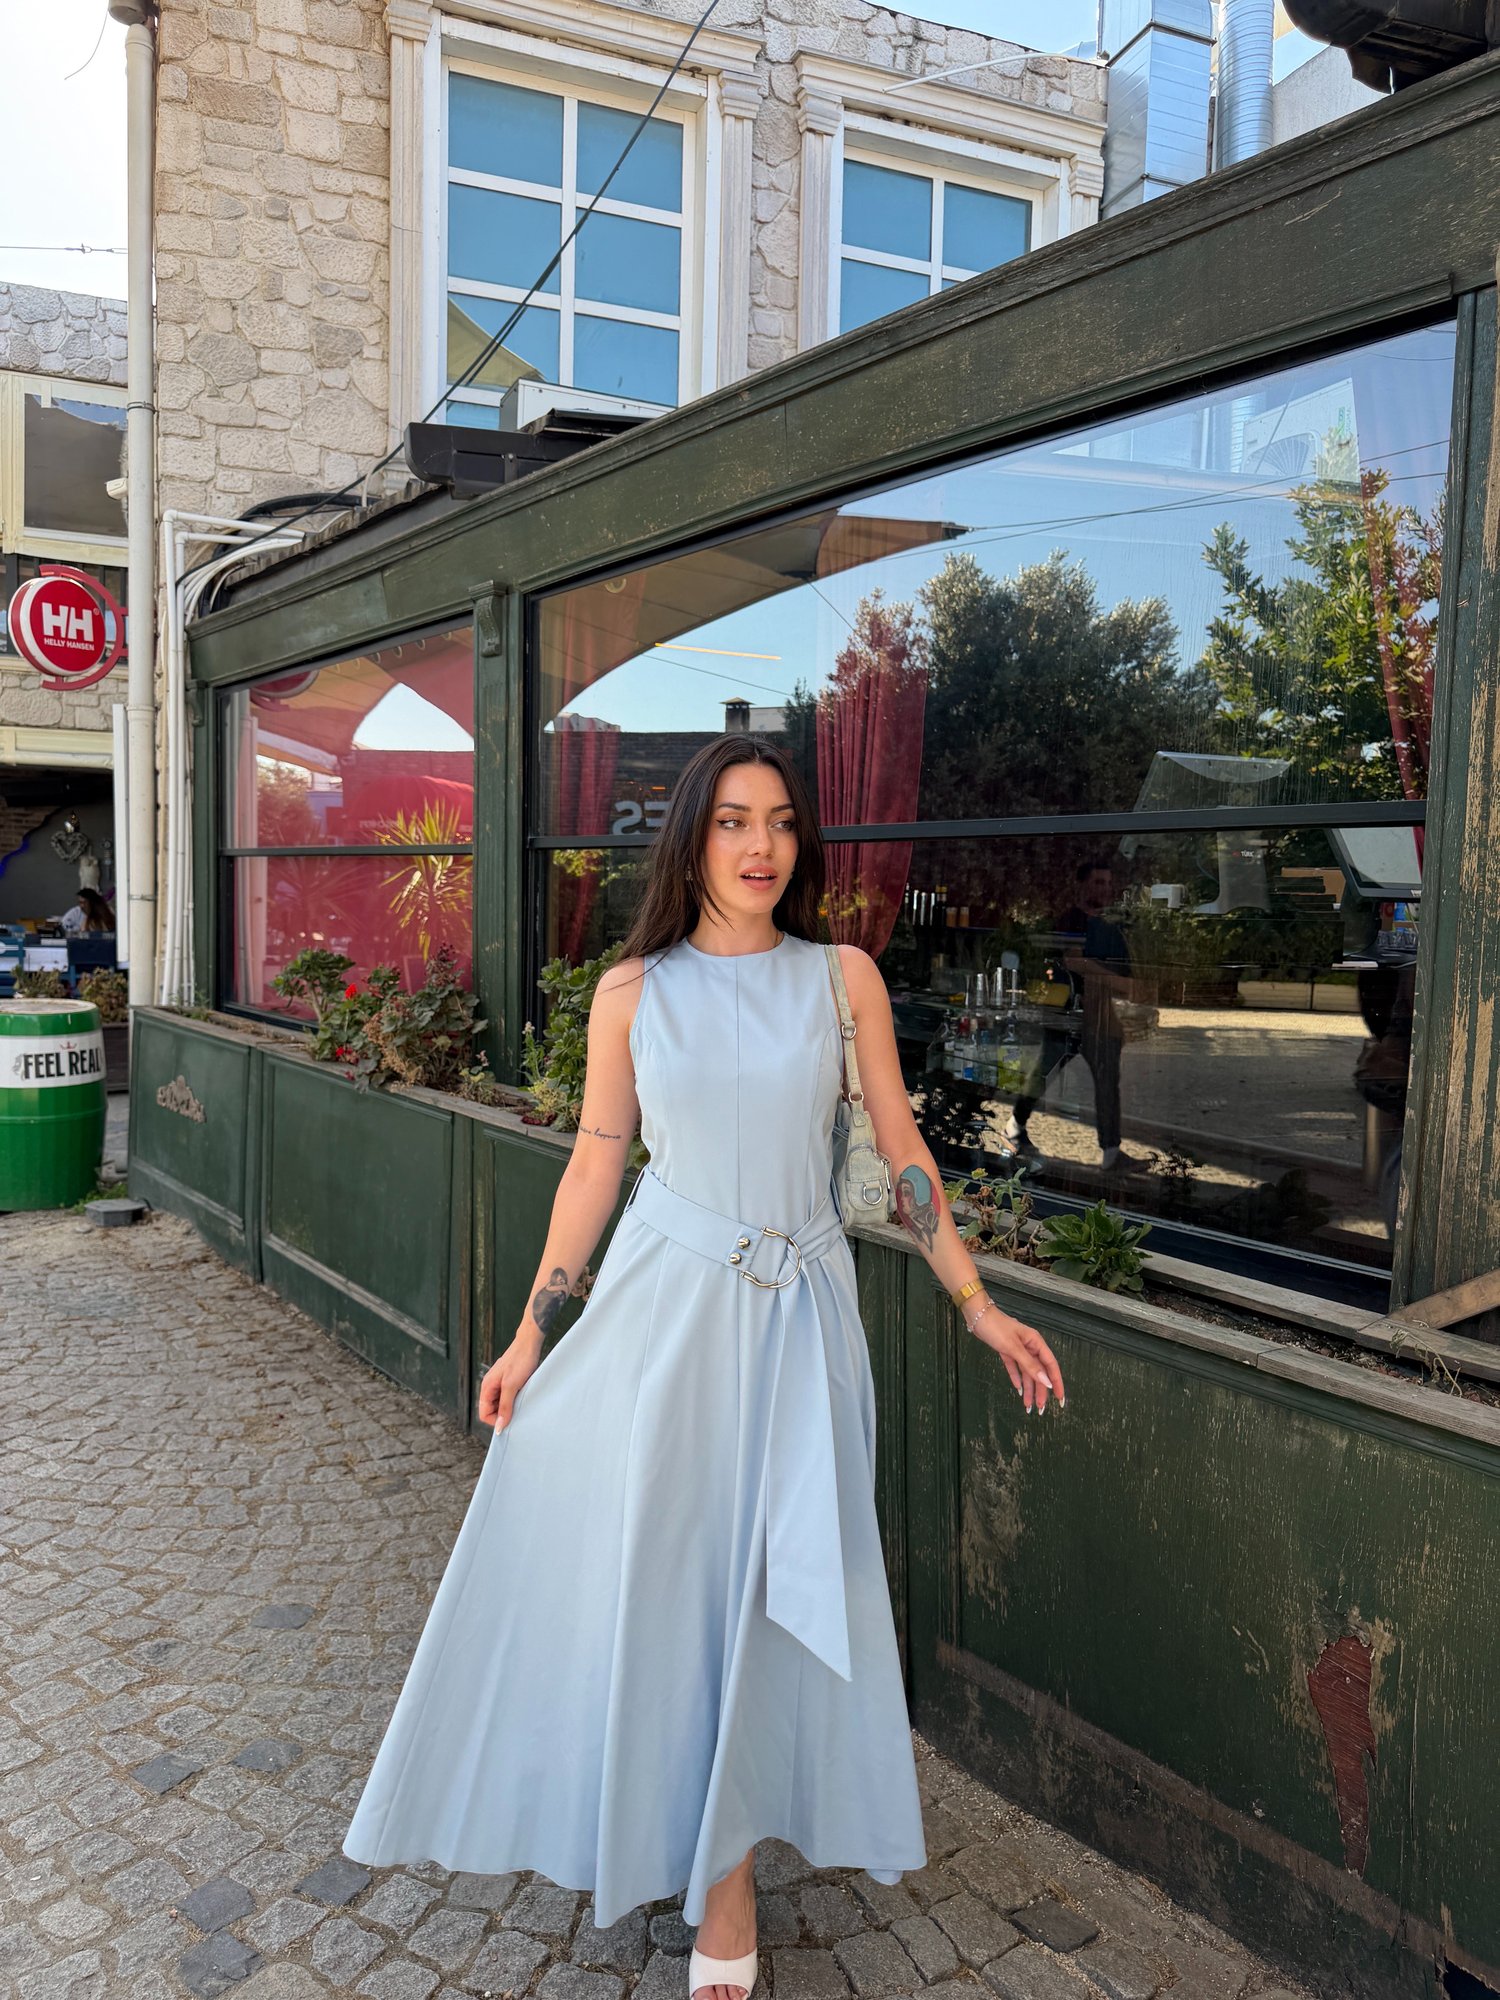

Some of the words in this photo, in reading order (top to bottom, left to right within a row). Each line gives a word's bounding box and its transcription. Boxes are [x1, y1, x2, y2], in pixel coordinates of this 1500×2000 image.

[42, 602, 94, 642] HH
[44, 637, 65, 647] HELLY
[66, 640, 95, 651] HANSEN
[23, 1052, 66, 1079] FEEL
[68, 1047, 101, 1076] REAL
